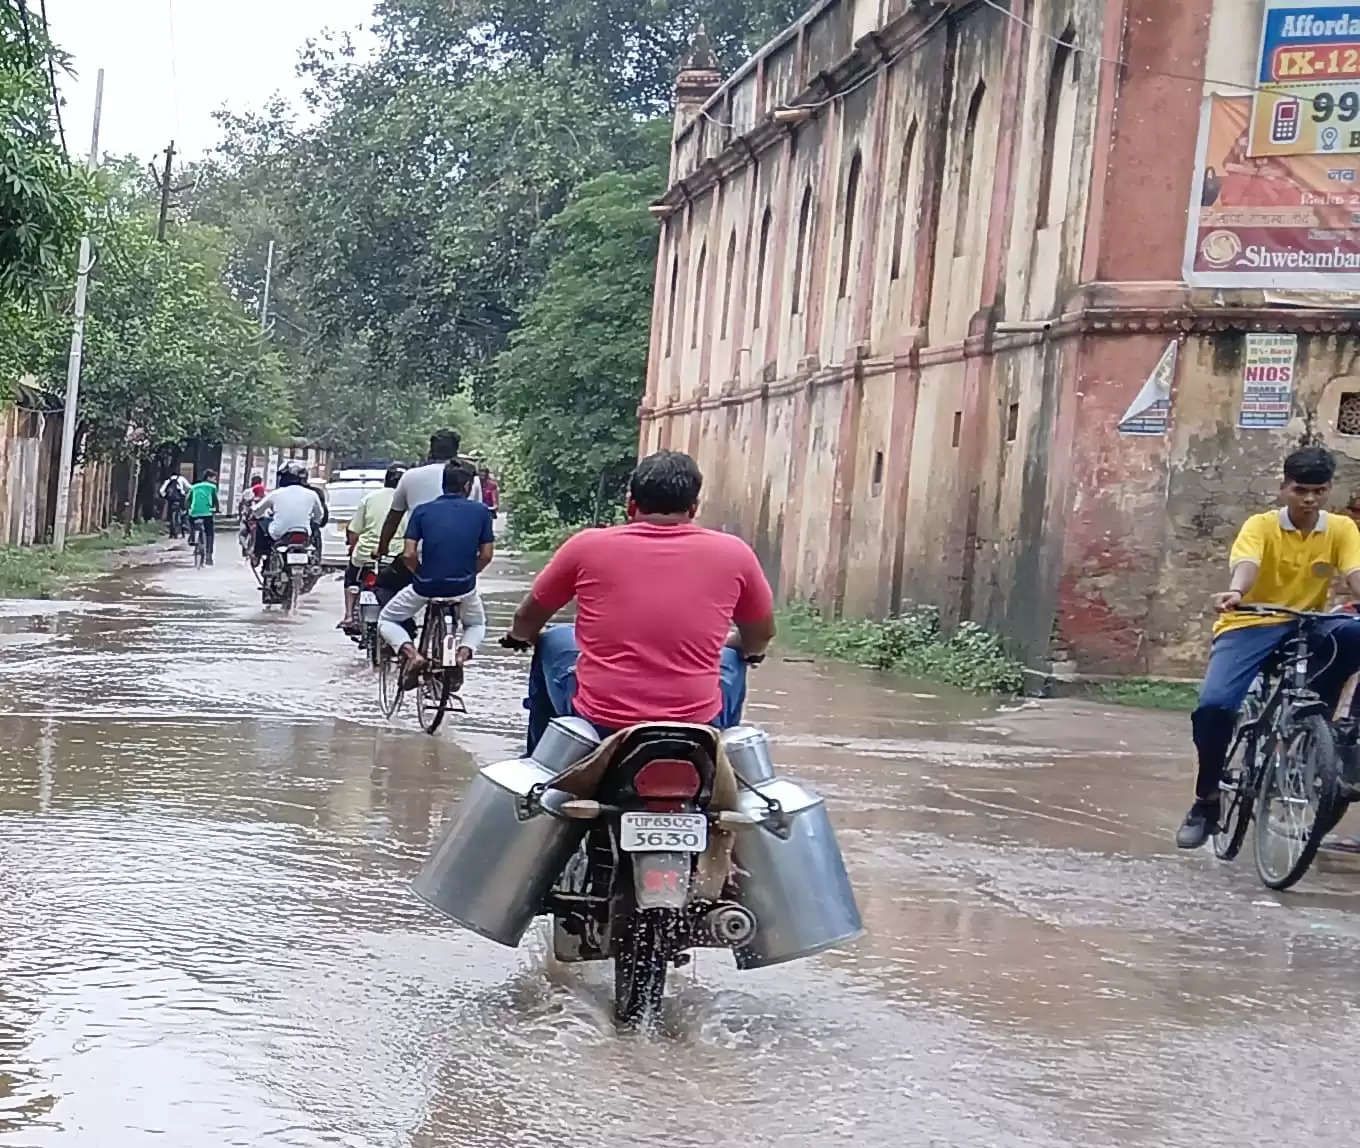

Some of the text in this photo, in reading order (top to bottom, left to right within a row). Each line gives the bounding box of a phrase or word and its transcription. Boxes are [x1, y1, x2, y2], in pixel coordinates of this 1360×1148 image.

[1278, 48, 1360, 76] IX-12
[1236, 245, 1360, 269] Shwetamba
[1246, 366, 1291, 382] NIOS
[632, 832, 699, 847] 5630
